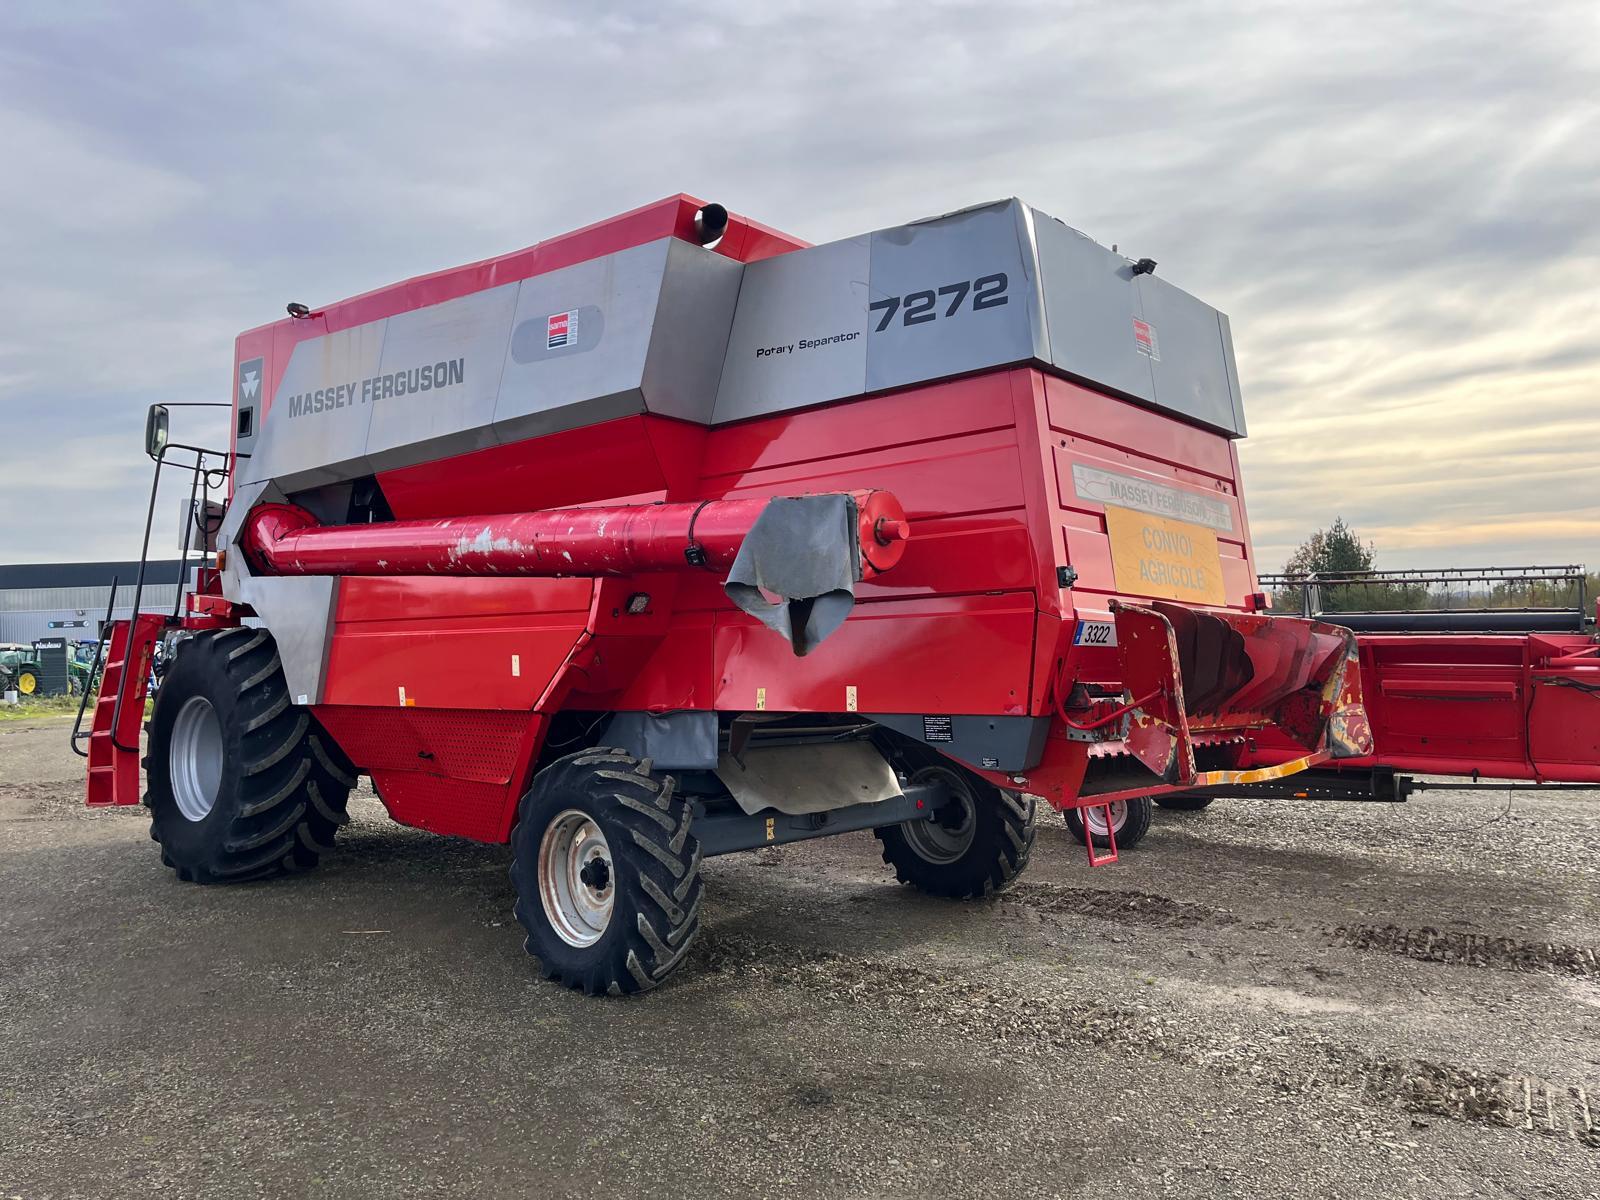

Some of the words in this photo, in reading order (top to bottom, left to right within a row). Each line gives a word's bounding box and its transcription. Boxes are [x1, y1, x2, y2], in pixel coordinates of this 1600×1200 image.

[869, 272, 1009, 332] 7272
[798, 330, 861, 350] Separator
[288, 382, 357, 419] MASSEY
[361, 357, 465, 404] FERGUSON
[1109, 480, 1154, 505] MASSEY
[1142, 526, 1194, 558] CONVOI
[1139, 559, 1206, 592] AGRICOLE
[1084, 624, 1111, 644] 3322
